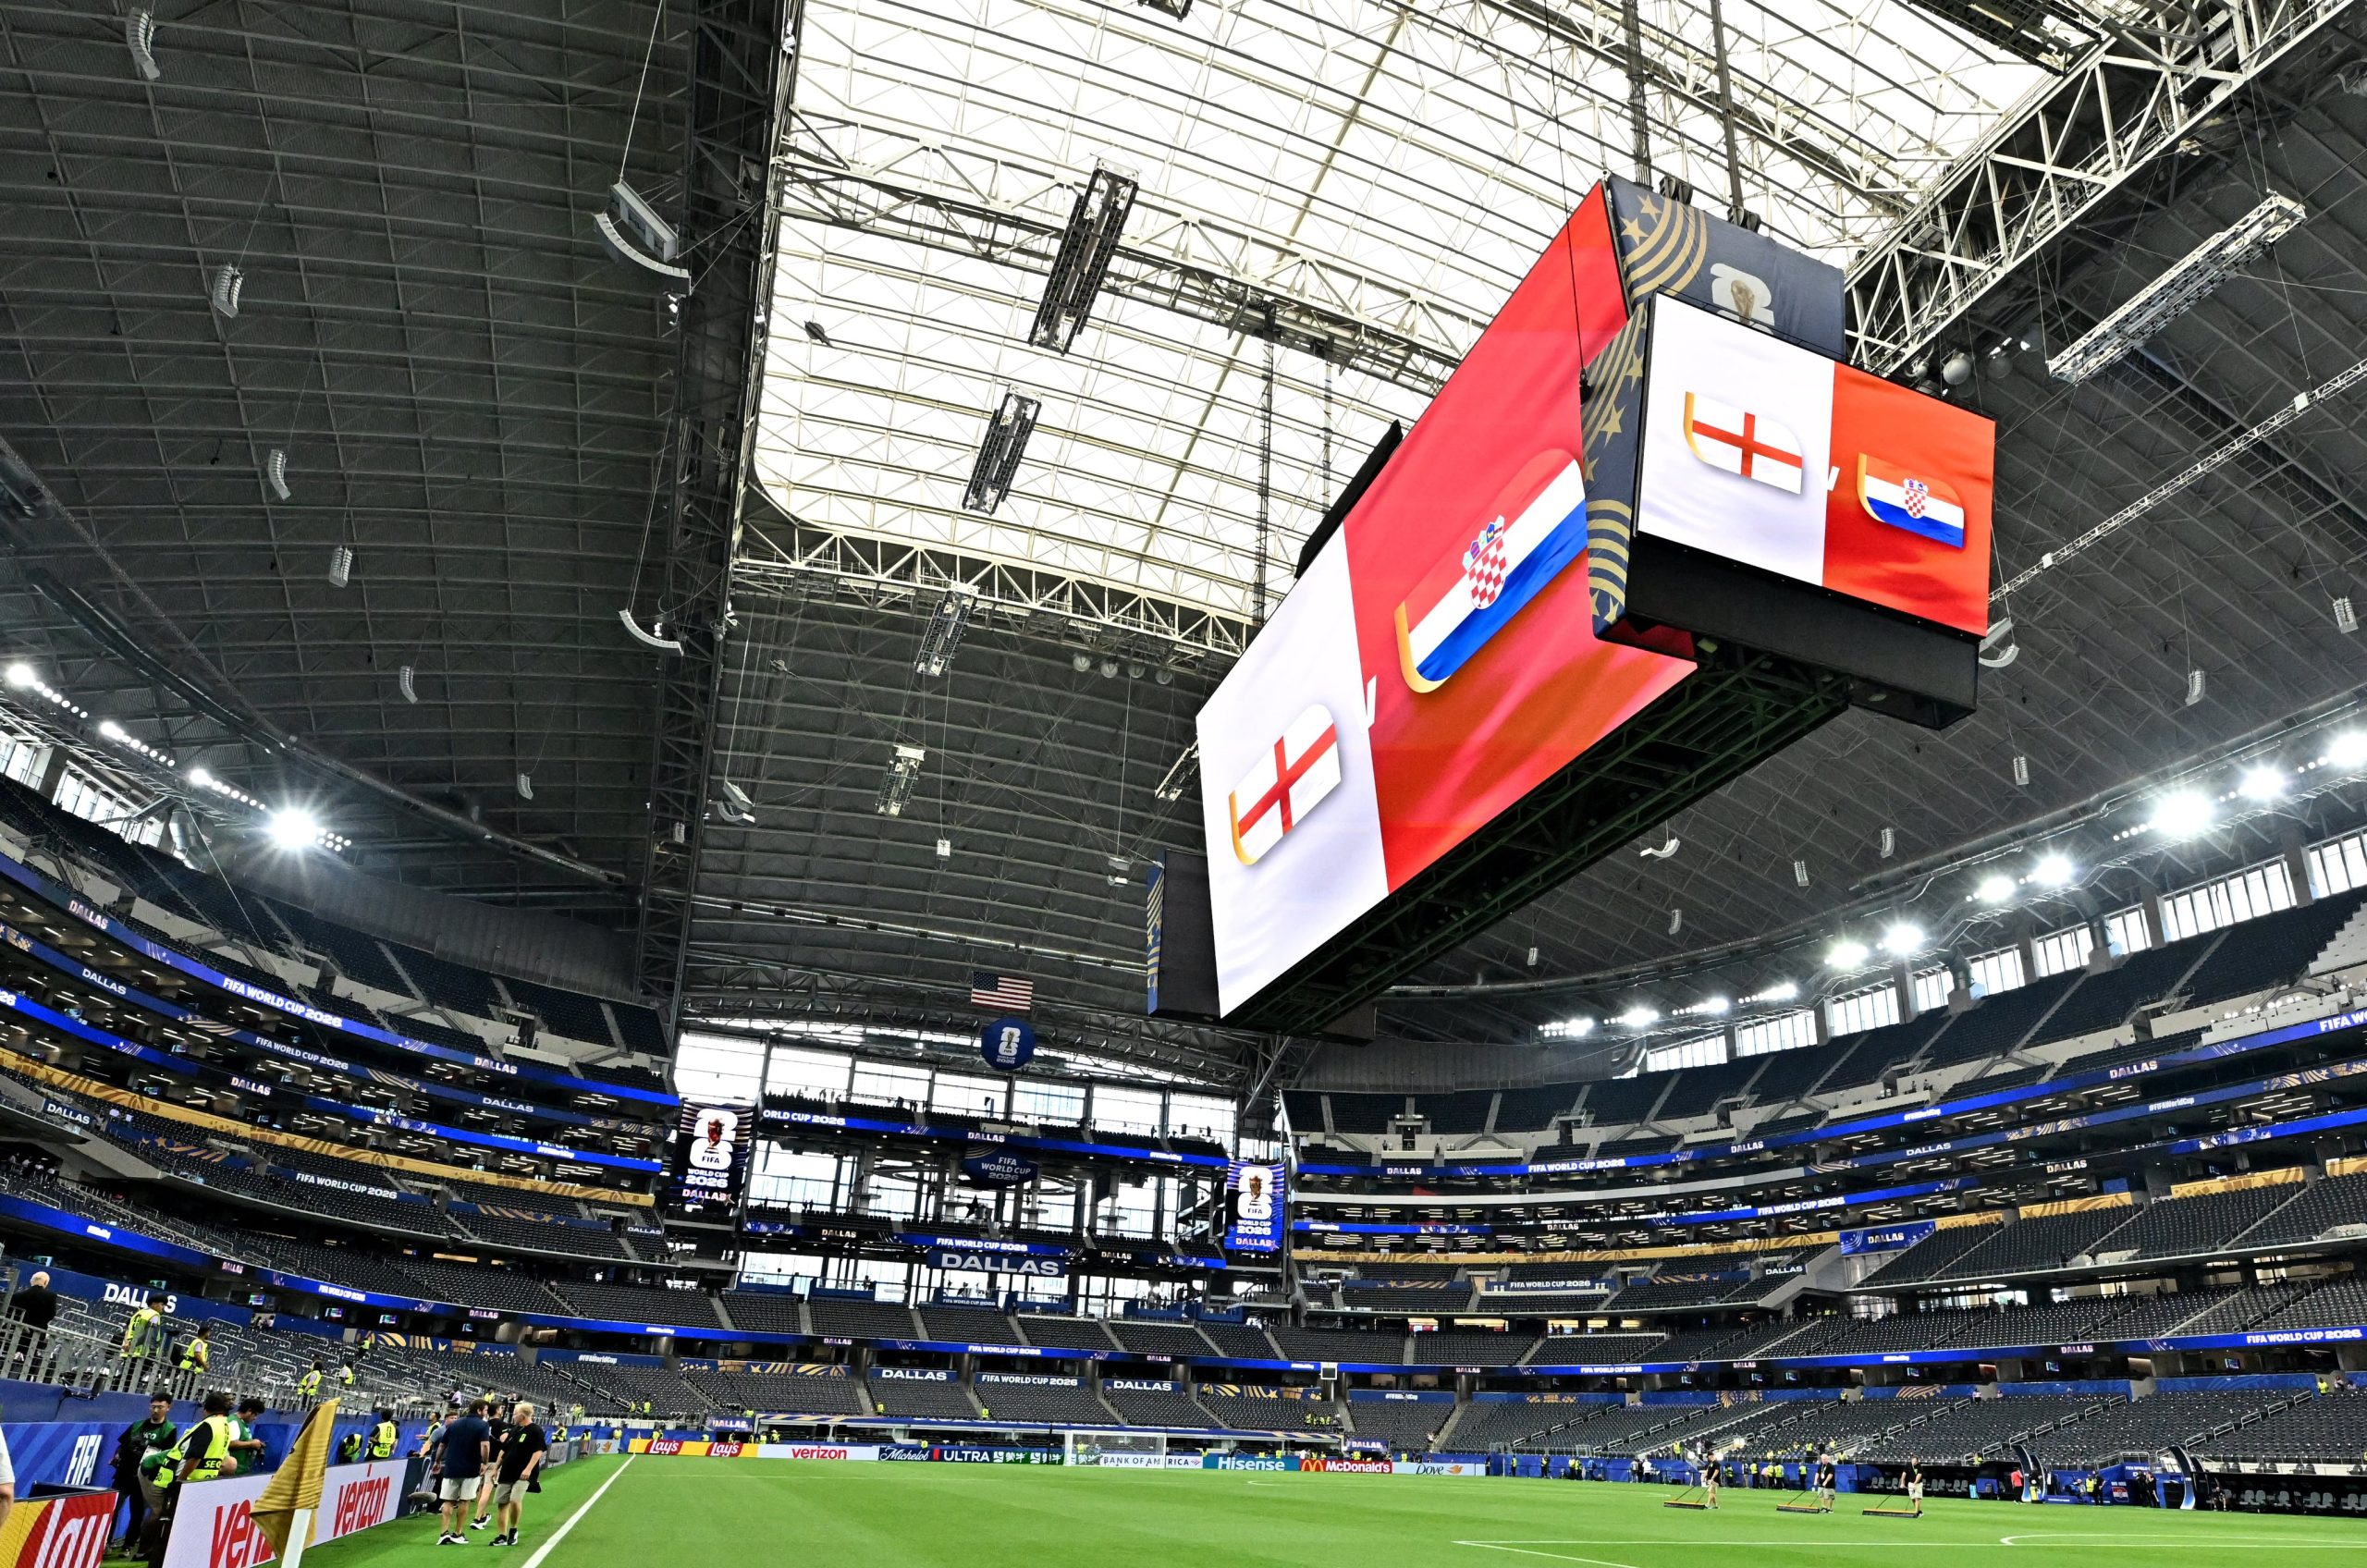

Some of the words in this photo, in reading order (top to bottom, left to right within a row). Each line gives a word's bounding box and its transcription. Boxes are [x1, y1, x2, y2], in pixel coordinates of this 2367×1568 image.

[69, 900, 109, 930] DALLAS
[82, 969, 128, 996] DALLAS
[223, 978, 245, 995] FIFA
[246, 986, 285, 1011] WORLD
[285, 998, 305, 1017] CUP
[305, 1008, 343, 1028] 2026
[2320, 1015, 2351, 1032] FIFA
[256, 1037, 273, 1049] FIFA
[273, 1042, 301, 1060] WORLD
[301, 1050, 319, 1063] CUP
[320, 1056, 349, 1071] 2026
[474, 1056, 518, 1075] DALLAS
[2110, 1060, 2158, 1080] DALLAS
[232, 1076, 271, 1096] DALLAS
[483, 1096, 534, 1113] DALLAS
[47, 1104, 91, 1125] DALLAS
[763, 1109, 790, 1120] ORLD
[791, 1112, 811, 1121] CUP
[811, 1115, 846, 1125] 2026
[968, 1132, 1005, 1143] DALLAS
[1731, 1141, 1764, 1154] DALLAS
[1907, 1143, 1951, 1156] DALLAS
[702, 1156, 719, 1164] FIFA
[999, 1157, 1017, 1166] FIFA
[2046, 1159, 2088, 1173] DALLAS
[688, 1169, 715, 1177] WORLD
[981, 1163, 1012, 1173] WORLD
[1014, 1167, 1031, 1175] CUP
[1387, 1167, 1422, 1175] DALLAS
[1528, 1165, 1547, 1173] FIFA
[1547, 1163, 1577, 1172] WORLD
[685, 1175, 729, 1188] 2026
[988, 1172, 1019, 1181] 2026
[296, 1172, 315, 1183] FIFA
[316, 1176, 349, 1190] WORLD
[350, 1183, 367, 1193] CUP
[367, 1187, 398, 1199] 2026
[682, 1189, 728, 1202] DALLAS
[1758, 1207, 1774, 1216] FIFA
[1773, 1203, 1801, 1213] WORLD
[1801, 1201, 1818, 1209] CUP
[1817, 1196, 1846, 1207] 2026
[627, 1226, 663, 1235] DALLAS
[822, 1229, 857, 1239] DALLAS
[1237, 1225, 1272, 1235] 2026
[937, 1238, 954, 1246] FIFA
[954, 1239, 983, 1248] WORLD
[984, 1241, 1000, 1249] CUP
[1235, 1237, 1272, 1247] DALLAS
[1868, 1232, 1904, 1243] DALLAS
[1101, 1251, 1132, 1260] DALLAS
[941, 1253, 1059, 1276] DALLAS
[1765, 1266, 1803, 1275] DALLAS
[104, 1283, 178, 1314] DALLS
[469, 1309, 498, 1319] DALLAS
[2247, 1334, 2267, 1343] FIFA
[2267, 1332, 2302, 1342] WORLD
[2303, 1330, 2324, 1340] CUP
[2324, 1329, 2362, 1339] 2026
[2061, 1344, 2093, 1354] DALLAS
[882, 1369, 947, 1381] DALLAS
[1001, 1376, 1031, 1384] WORLD
[1049, 1378, 1078, 1386] 2026
[1113, 1380, 1172, 1391] DALLAS
[712, 1419, 747, 1428] DALLAS
[650, 1439, 680, 1454] Lay's
[711, 1442, 740, 1457] Lay's
[792, 1446, 847, 1460] verizon
[65, 1435, 103, 1485] FIFA
[879, 1447, 930, 1461] Michelob
[944, 1451, 990, 1462] ULTRA
[1104, 1456, 1130, 1464] BANK
[1147, 1457, 1190, 1466] AMRICA
[1218, 1456, 1285, 1471] Hisense
[1326, 1462, 1390, 1473] McDonald's
[1416, 1463, 1444, 1476] Dove
[334, 1464, 390, 1537] verizon
